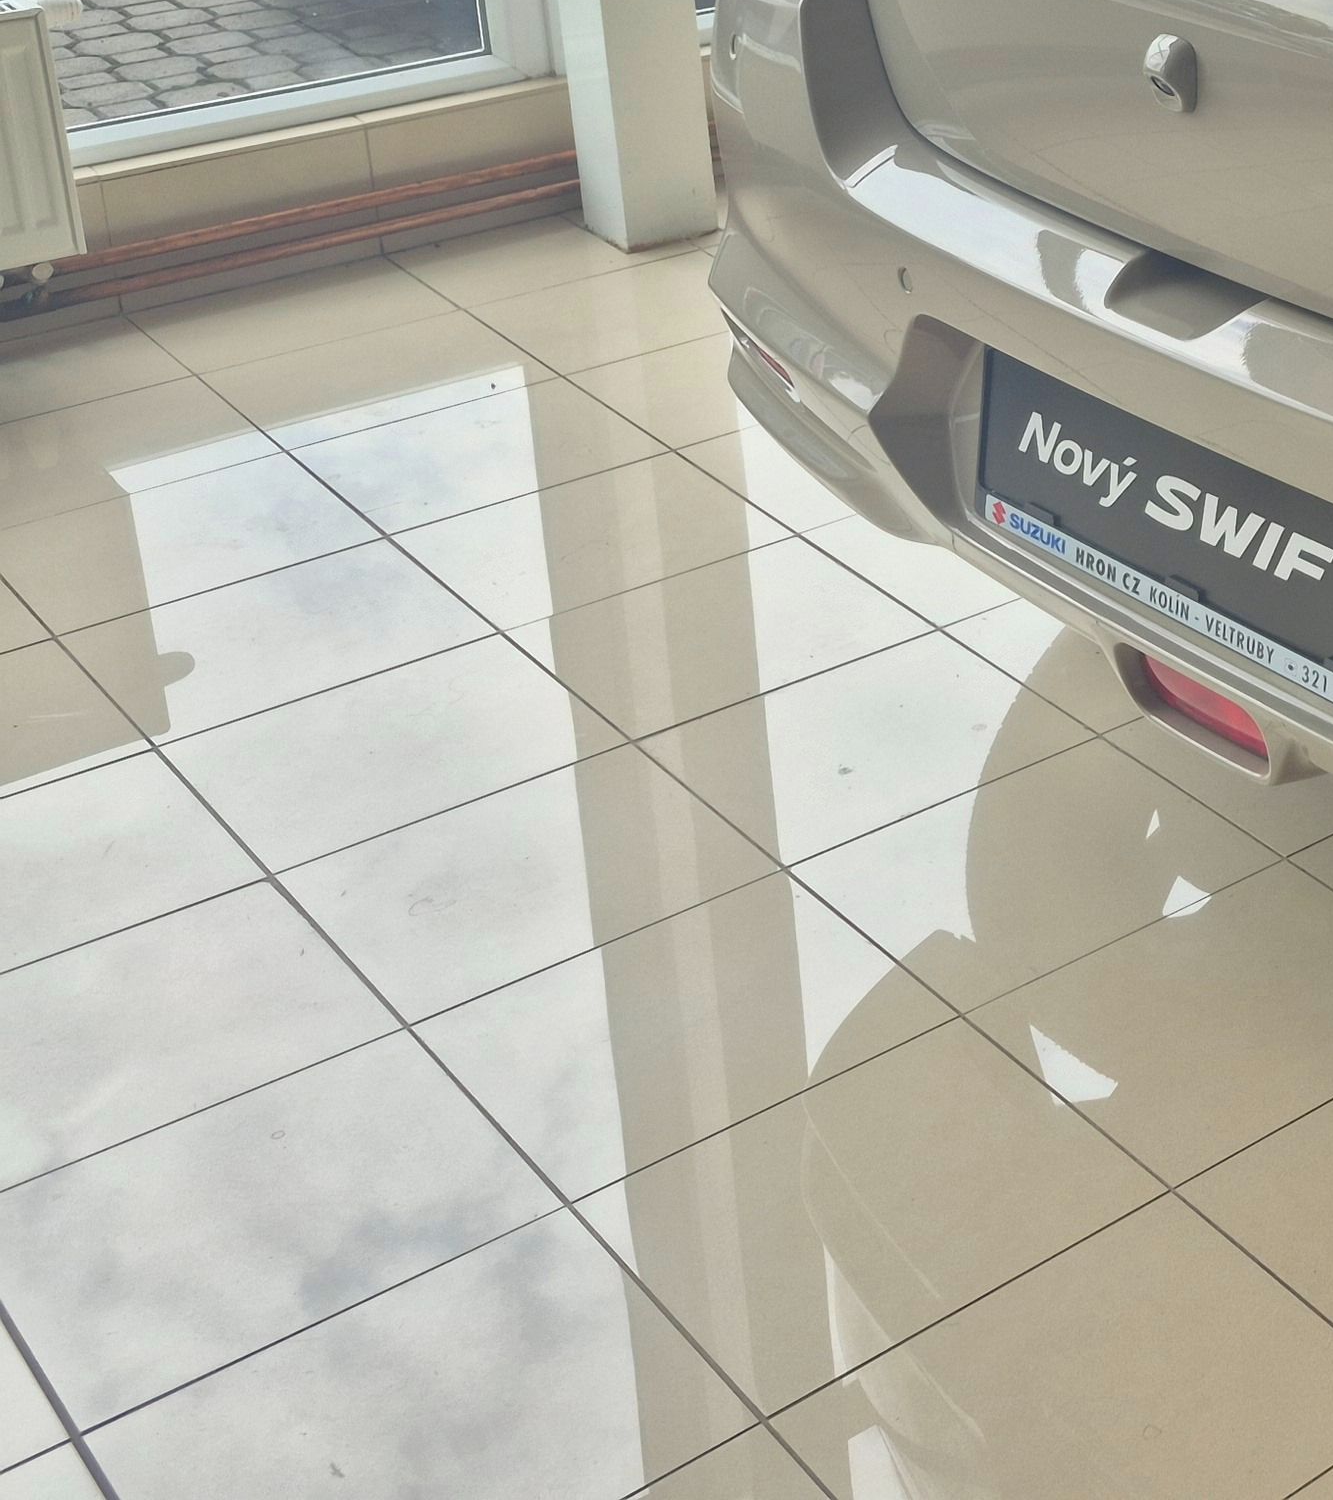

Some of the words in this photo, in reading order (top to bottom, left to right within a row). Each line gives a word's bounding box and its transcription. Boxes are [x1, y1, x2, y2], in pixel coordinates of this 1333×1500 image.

[1018, 410, 1138, 508] Nový
[1009, 512, 1066, 554] SUZUKI
[1075, 546, 1117, 582] HRON
[1122, 572, 1141, 595] CZ
[1149, 584, 1190, 621] KOLÍN
[1204, 613, 1275, 664] VELTRUBY
[1301, 665, 1328, 693] 321
